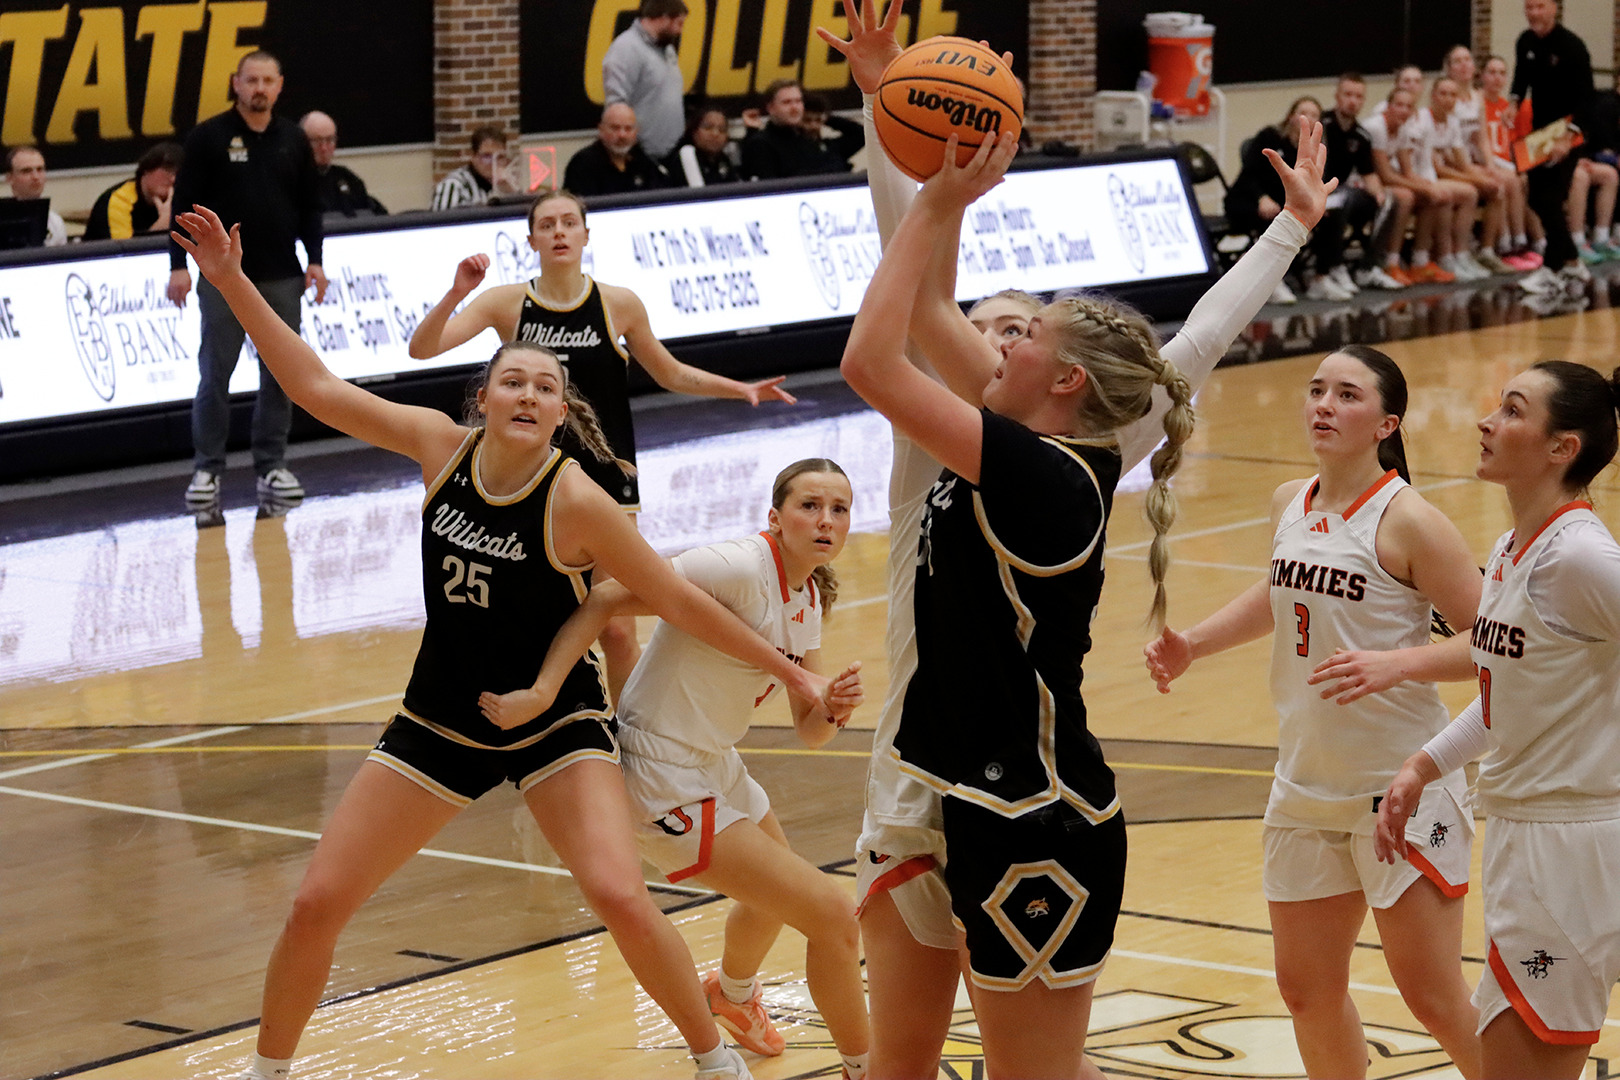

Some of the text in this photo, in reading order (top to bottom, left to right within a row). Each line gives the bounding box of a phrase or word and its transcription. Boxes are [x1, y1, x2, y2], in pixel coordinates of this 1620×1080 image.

[935, 50, 997, 77] EVO
[907, 87, 1002, 137] Wilson
[116, 316, 190, 367] BANK
[313, 313, 350, 352] 8am
[355, 309, 391, 355] 5pm
[522, 322, 602, 348] Wildcats
[431, 502, 528, 562] Wildcats
[442, 554, 493, 609] 25
[1294, 601, 1310, 658] 3
[1473, 661, 1492, 731] 0
